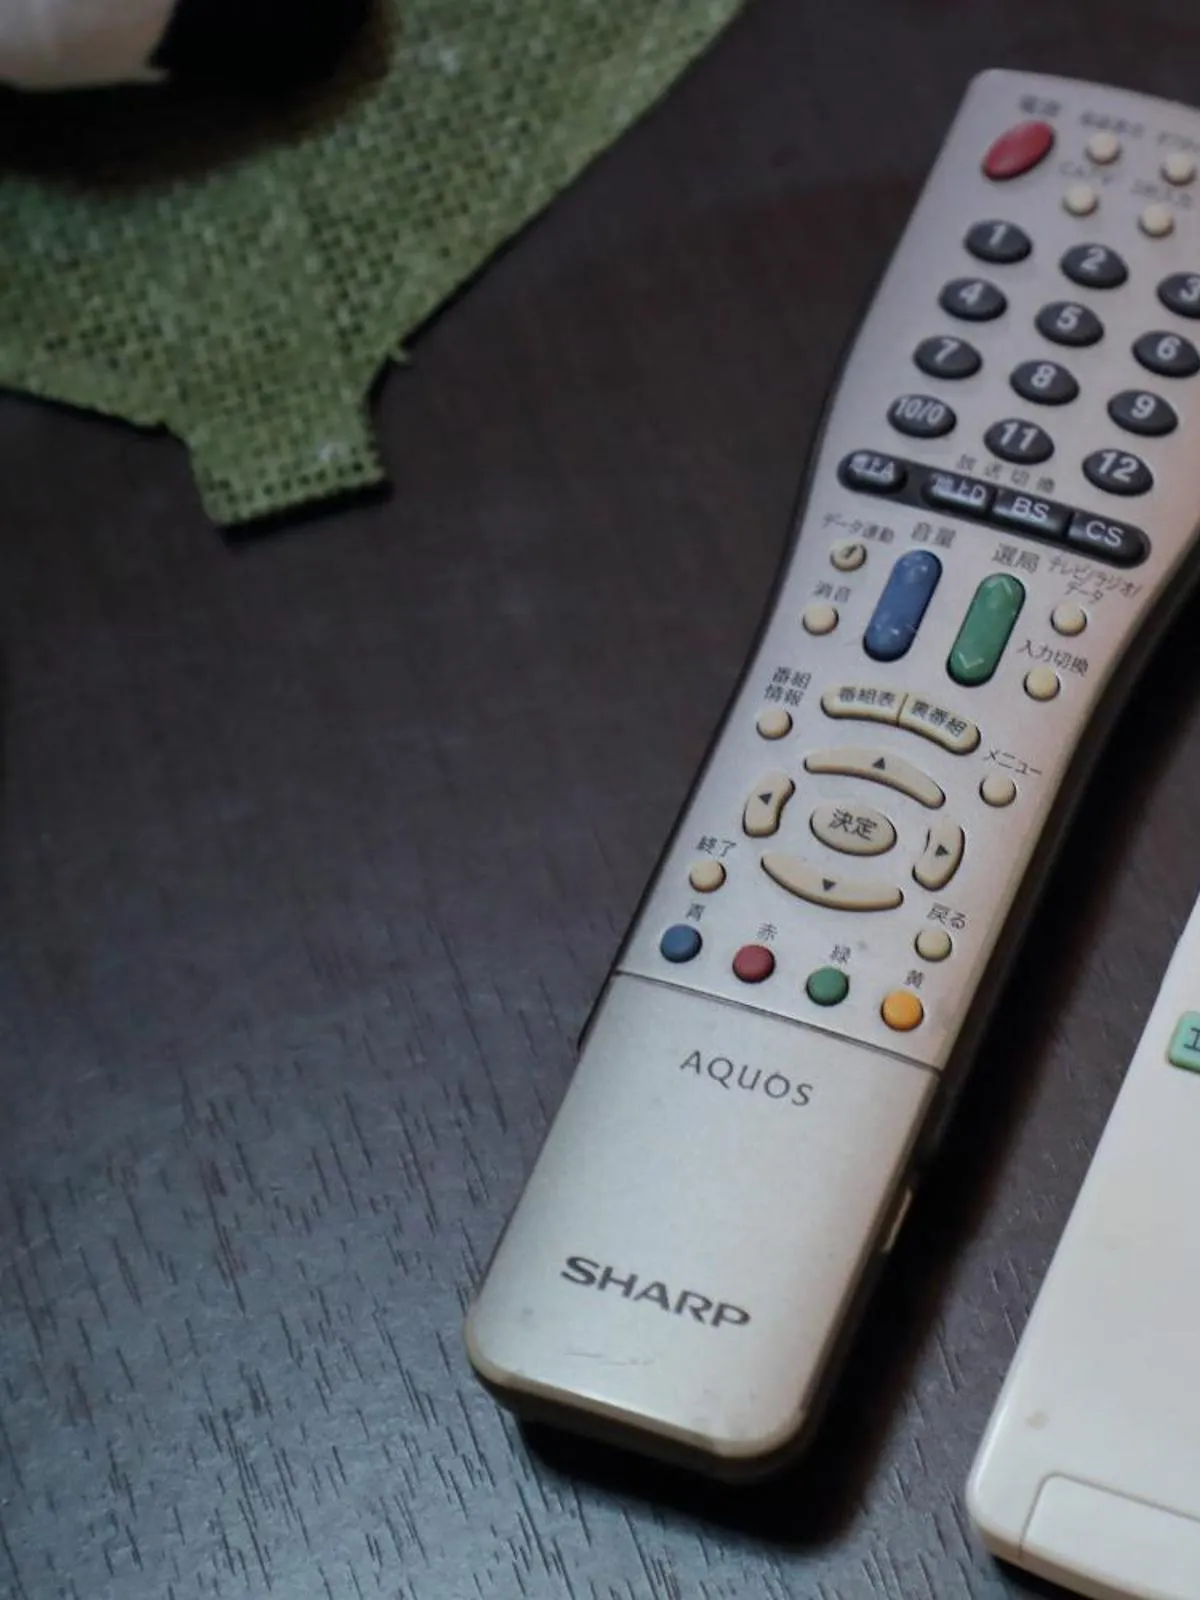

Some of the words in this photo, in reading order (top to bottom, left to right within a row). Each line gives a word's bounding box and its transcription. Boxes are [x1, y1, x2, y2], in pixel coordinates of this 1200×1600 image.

[988, 224, 1007, 246] 1
[1079, 247, 1108, 271] 2
[959, 283, 985, 306] 4
[1056, 306, 1083, 331] 5
[934, 339, 960, 364] 7
[1156, 335, 1182, 361] 6
[1030, 363, 1057, 389] 8
[894, 396, 946, 426] 10/0
[1130, 393, 1157, 419] 9
[999, 422, 1039, 451] 11
[1099, 450, 1138, 482] 12
[1010, 496, 1050, 522] BS
[1085, 520, 1124, 548] CS
[1016, 639, 1090, 677] 入力切換
[983, 749, 1043, 777] メニュー
[828, 808, 878, 841] 決定
[926, 902, 967, 930] 戻る
[756, 922, 778, 942] 赤
[680, 1049, 814, 1107] AQUOS
[560, 1255, 752, 1328] SHARP
